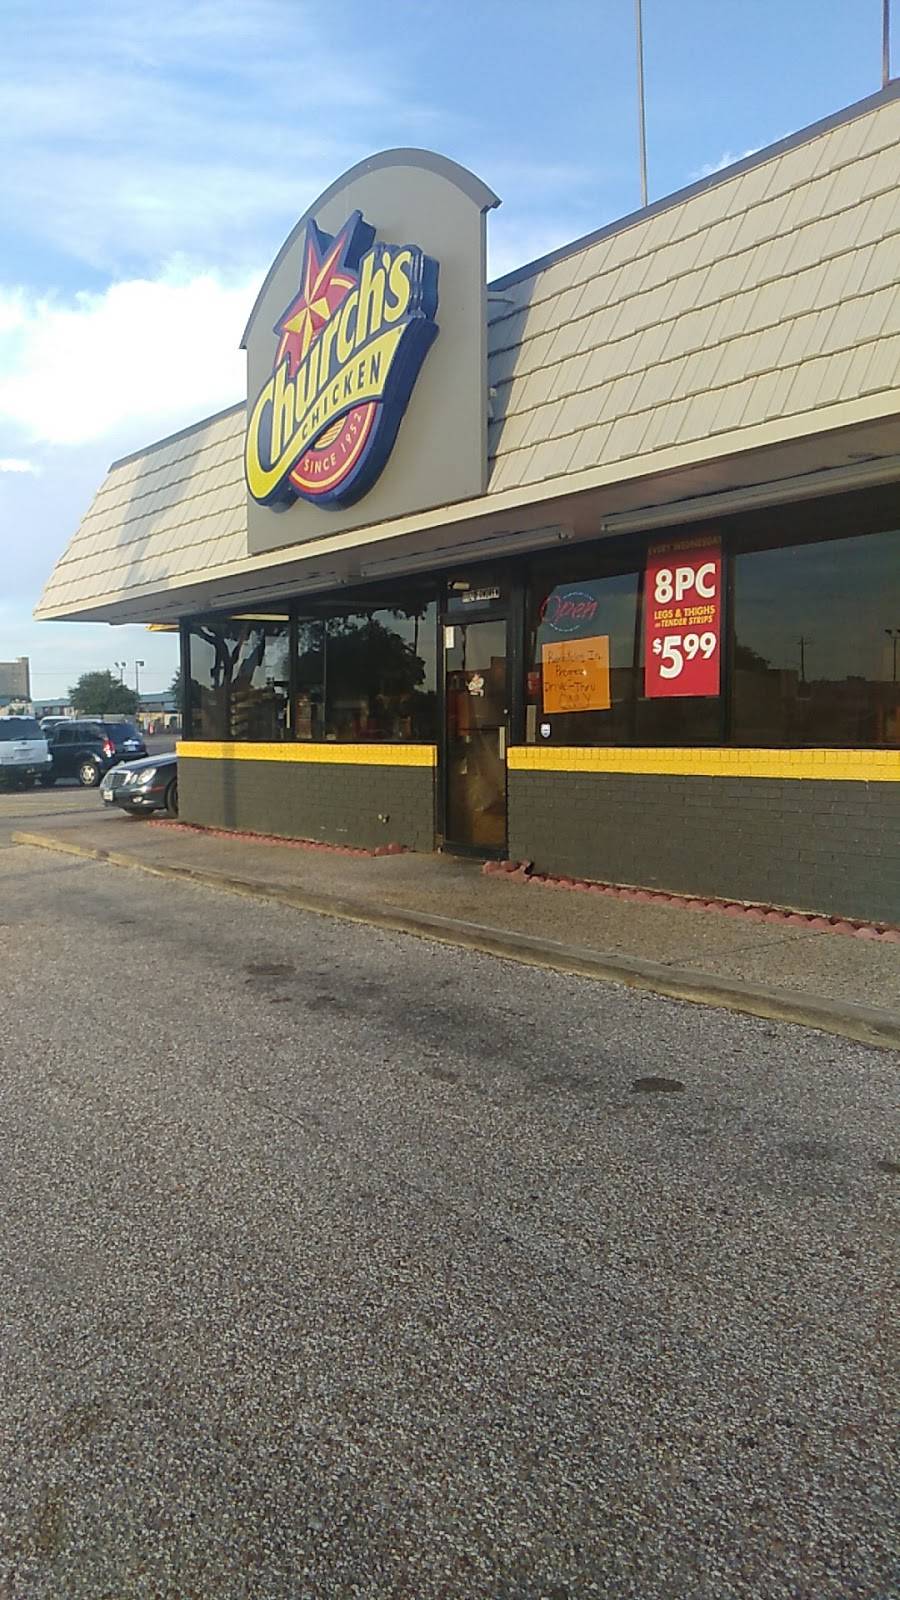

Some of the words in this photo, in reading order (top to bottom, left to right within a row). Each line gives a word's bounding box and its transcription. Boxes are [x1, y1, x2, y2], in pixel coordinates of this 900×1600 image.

[244, 251, 412, 499] Church's
[301, 351, 382, 441] CHICKEN
[303, 452, 337, 475] SINCE
[341, 412, 362, 453] 1952
[654, 562, 716, 604] 8PC
[539, 595, 598, 622] Open
[654, 609, 674, 620] LEGS
[675, 608, 682, 618] &
[684, 605, 716, 617] THIGHS
[661, 617, 687, 627] TENDER
[688, 615, 713, 625] STRIPS
